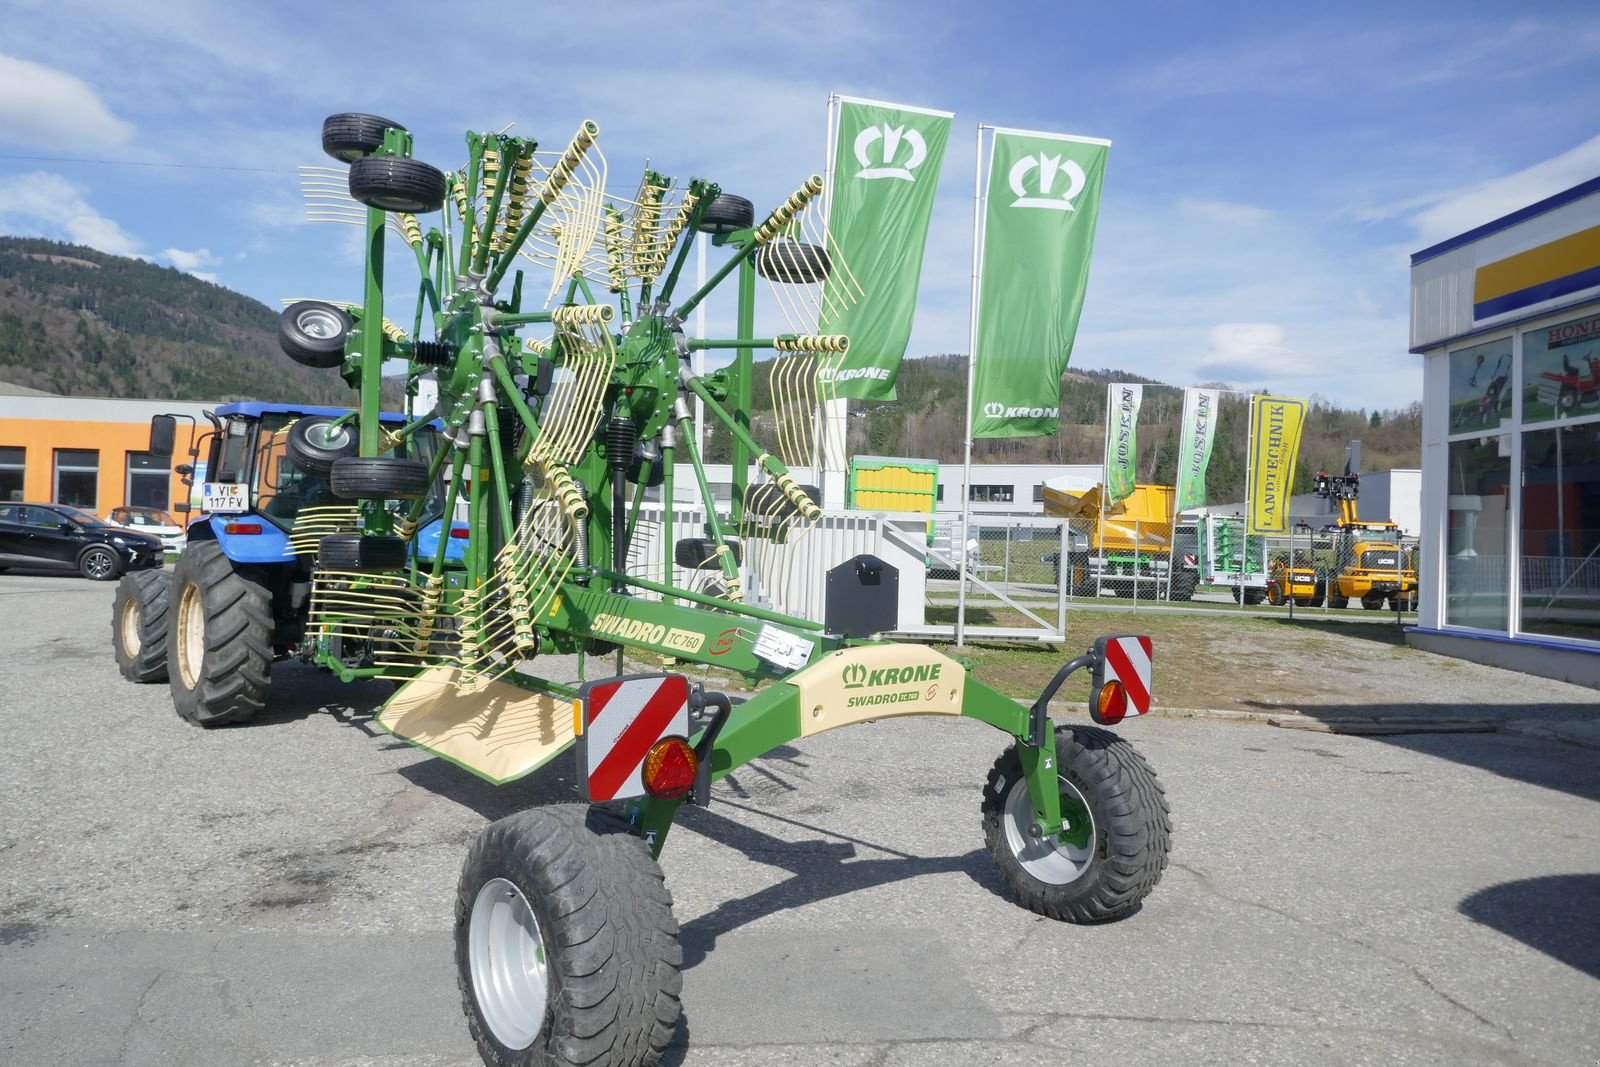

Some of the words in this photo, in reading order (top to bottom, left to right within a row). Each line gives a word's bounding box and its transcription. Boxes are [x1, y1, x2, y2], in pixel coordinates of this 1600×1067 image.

[835, 367, 891, 381] KRONE
[1004, 407, 1060, 418] KRON
[1117, 387, 1134, 470] JOSKIN
[1193, 393, 1210, 478] JOSKIN
[1263, 404, 1284, 527] LANDTECHNIK
[209, 497, 226, 508] 117
[229, 497, 243, 508] FV
[590, 613, 666, 645] SWADRO
[667, 633, 682, 645] TC
[682, 635, 700, 649] 760
[867, 663, 943, 687] KRONE
[847, 693, 898, 707] SWADRO
